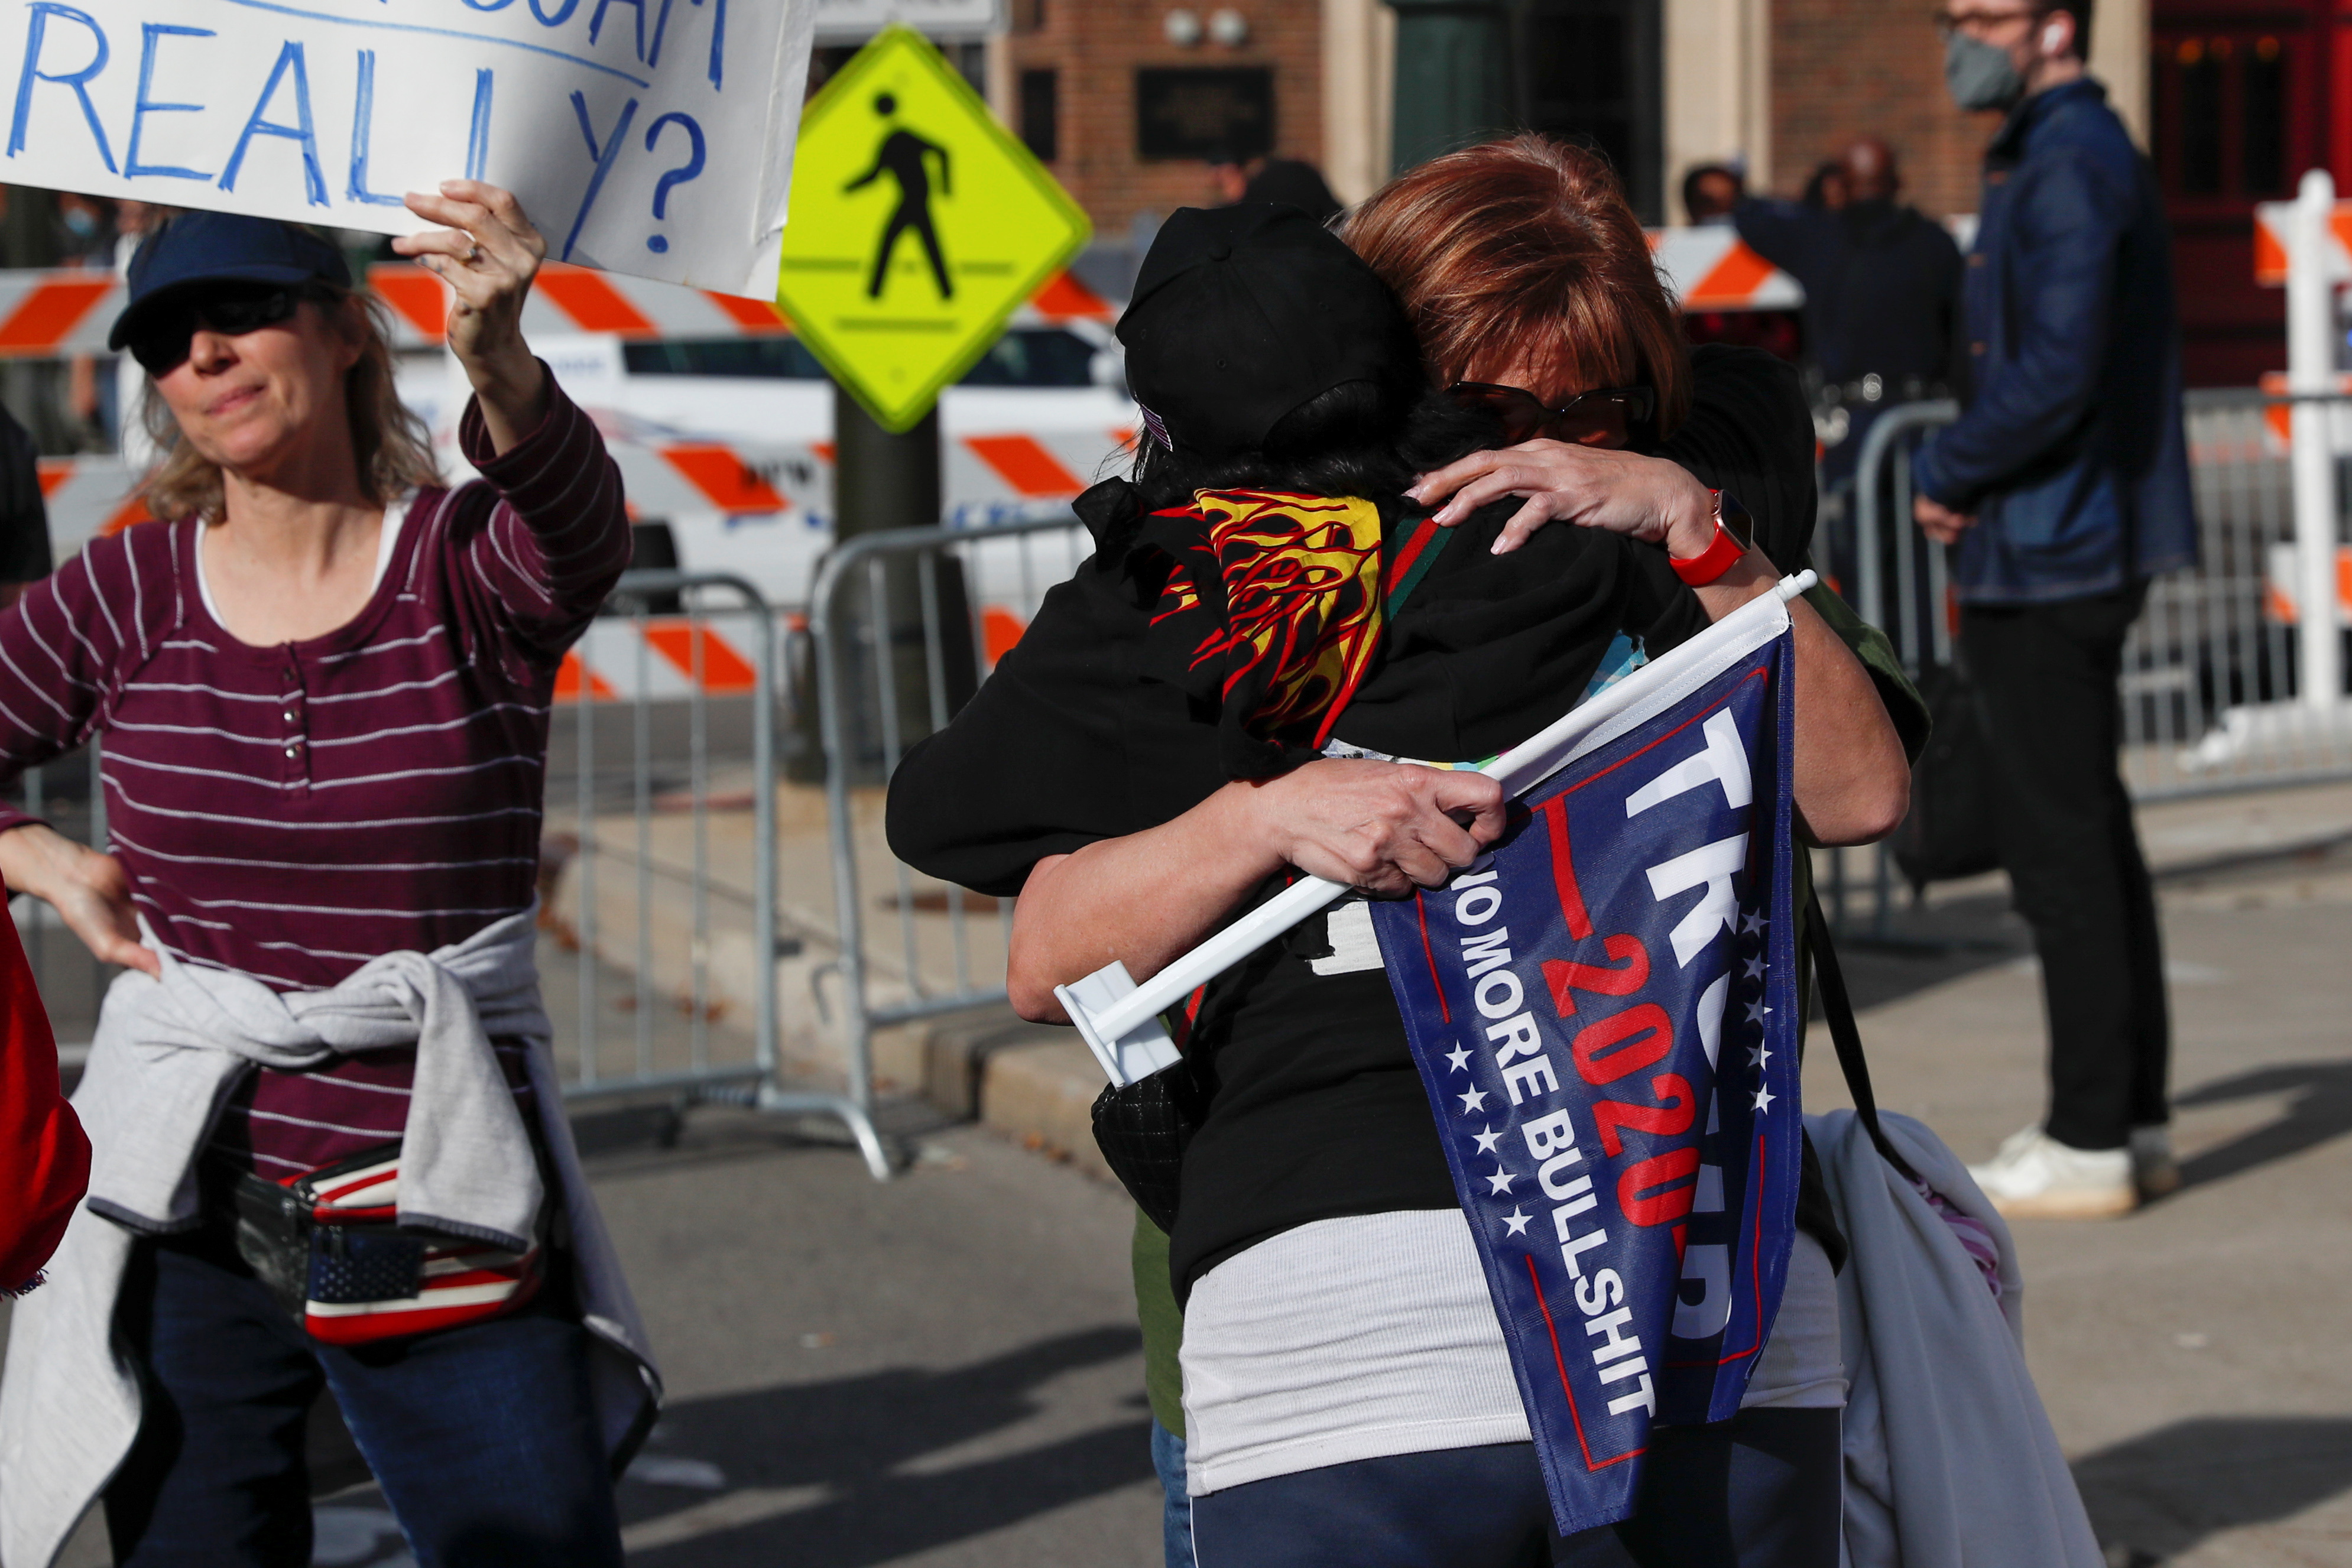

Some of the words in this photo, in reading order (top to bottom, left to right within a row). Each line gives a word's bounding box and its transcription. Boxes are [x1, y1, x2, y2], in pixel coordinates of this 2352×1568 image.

[6, 2, 706, 261] REALLY?
[1460, 926, 1559, 1106] MORE
[1521, 1108, 1656, 1417] BULLSHIT
[1540, 933, 1700, 1227] 2020
